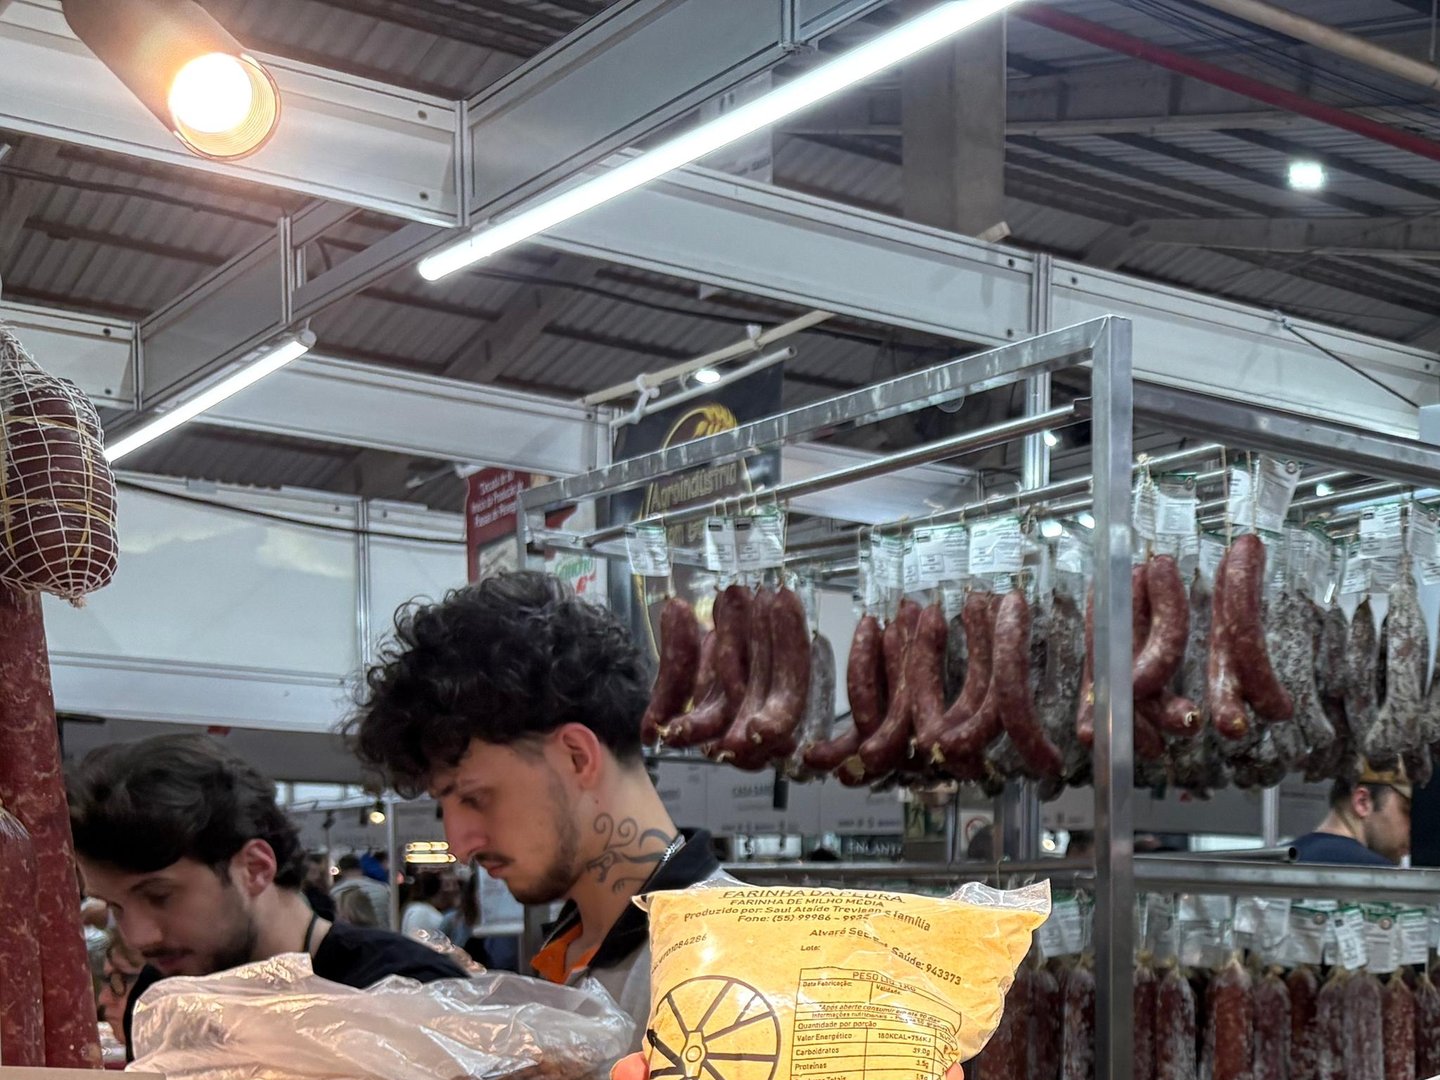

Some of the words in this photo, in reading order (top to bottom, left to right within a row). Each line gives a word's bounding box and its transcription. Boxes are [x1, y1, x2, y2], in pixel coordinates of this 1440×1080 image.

[723, 889, 806, 898] FARINHA
[684, 907, 738, 922] Produzido
[765, 906, 791, 914] Saul
[893, 911, 931, 931] família
[809, 927, 846, 936] Alvará
[891, 946, 924, 970] Saúde:
[926, 963, 962, 986] 943373
[852, 971, 878, 980] PESO
[798, 1021, 838, 1030] Quantidade
[840, 1022, 851, 1030] por
[853, 1020, 877, 1030] porção
[796, 1033, 814, 1041] Valor
[815, 1032, 852, 1043] Energético
[796, 1047, 839, 1056] Carboidratos
[795, 1061, 827, 1070] Proteínas
